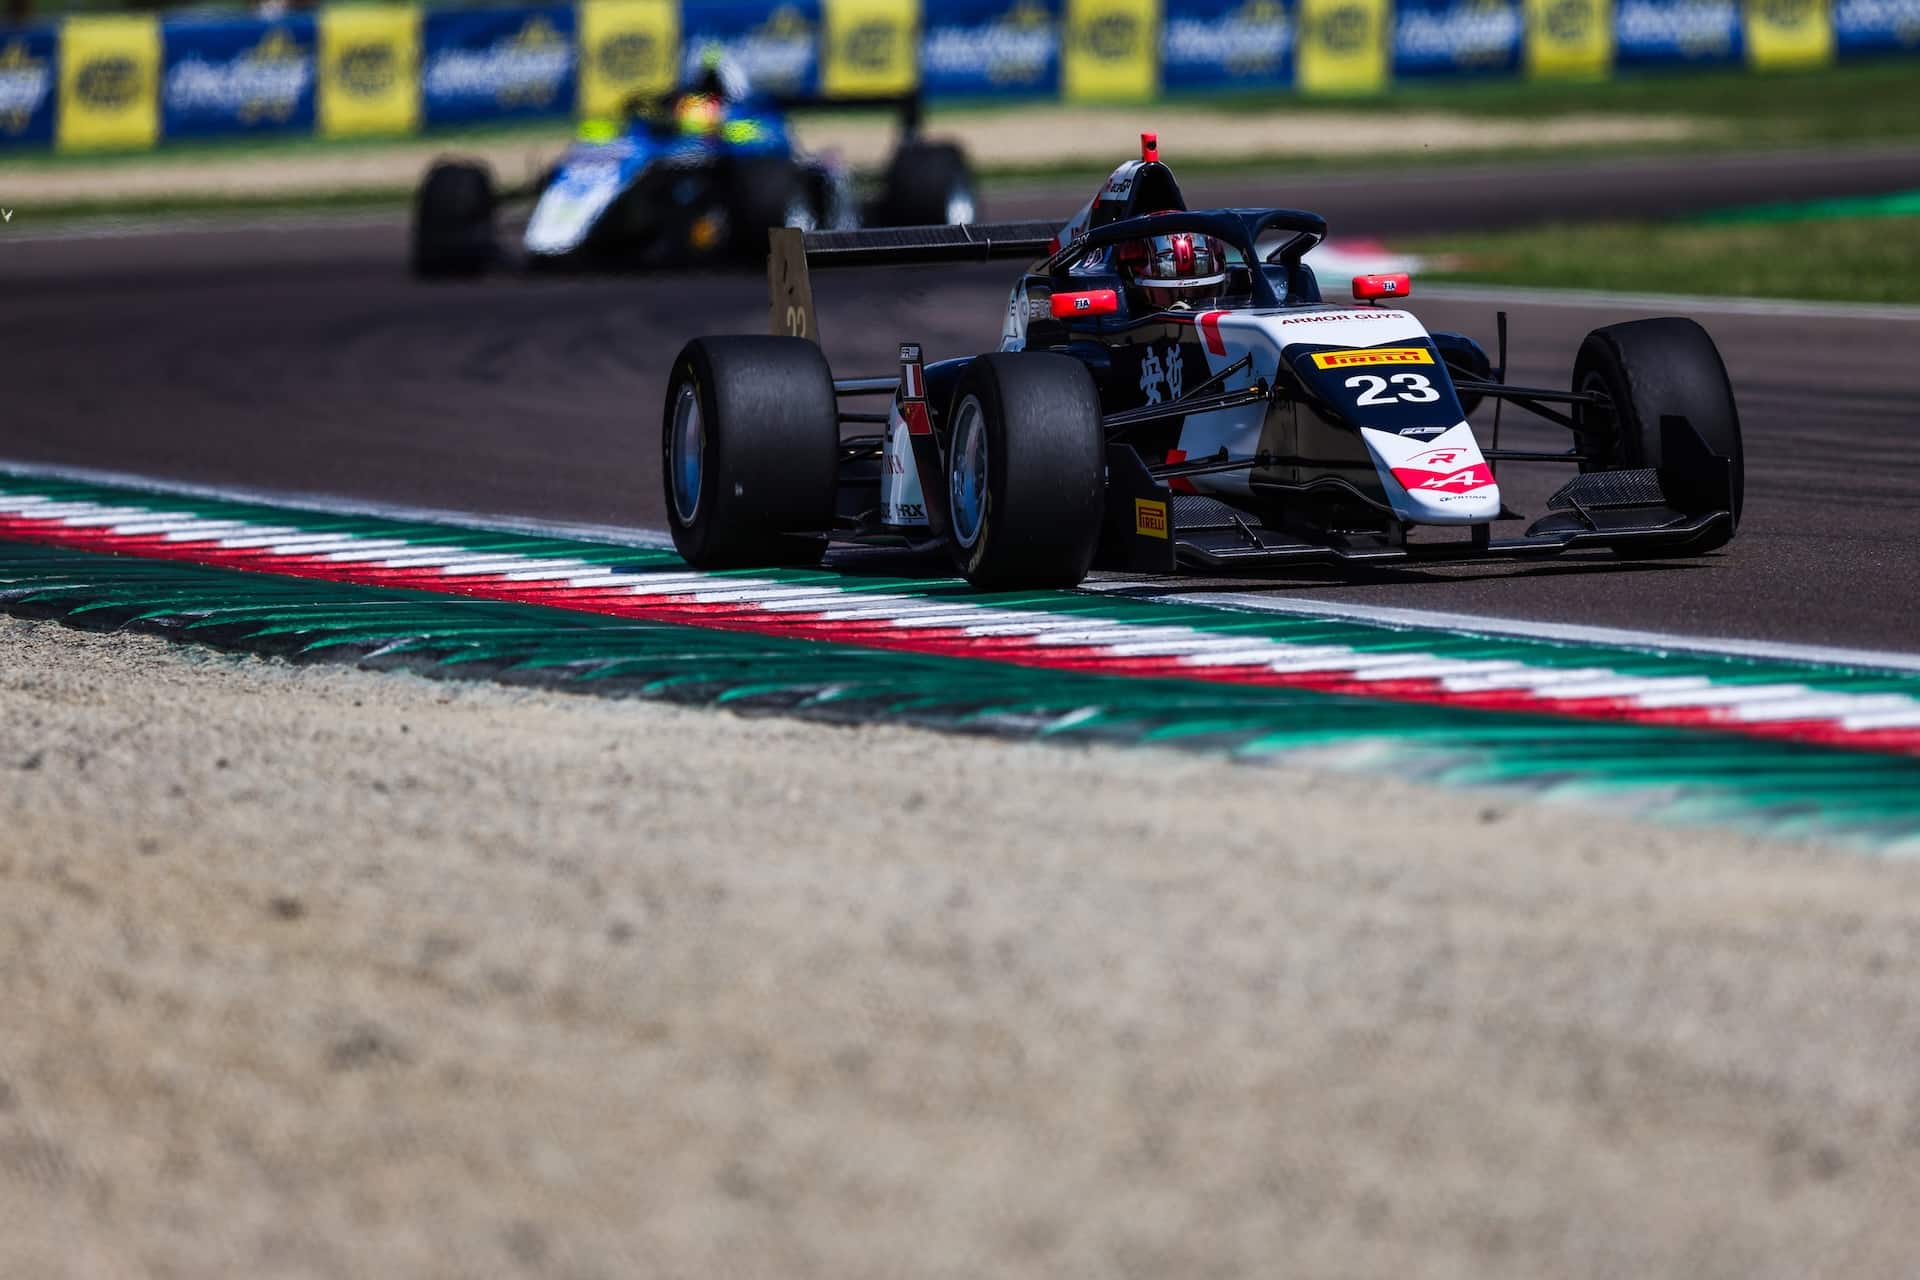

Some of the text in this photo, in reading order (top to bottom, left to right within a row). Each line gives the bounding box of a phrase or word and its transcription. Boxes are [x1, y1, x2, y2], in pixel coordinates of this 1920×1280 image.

[1384, 281, 1396, 290] FIA
[1075, 299, 1089, 307] FIA
[1282, 313, 1405, 325] ARMOR GUYS
[1323, 351, 1422, 365] PIRELLI
[1345, 373, 1441, 407] 23
[1139, 506, 1164, 530] PIRELLI
